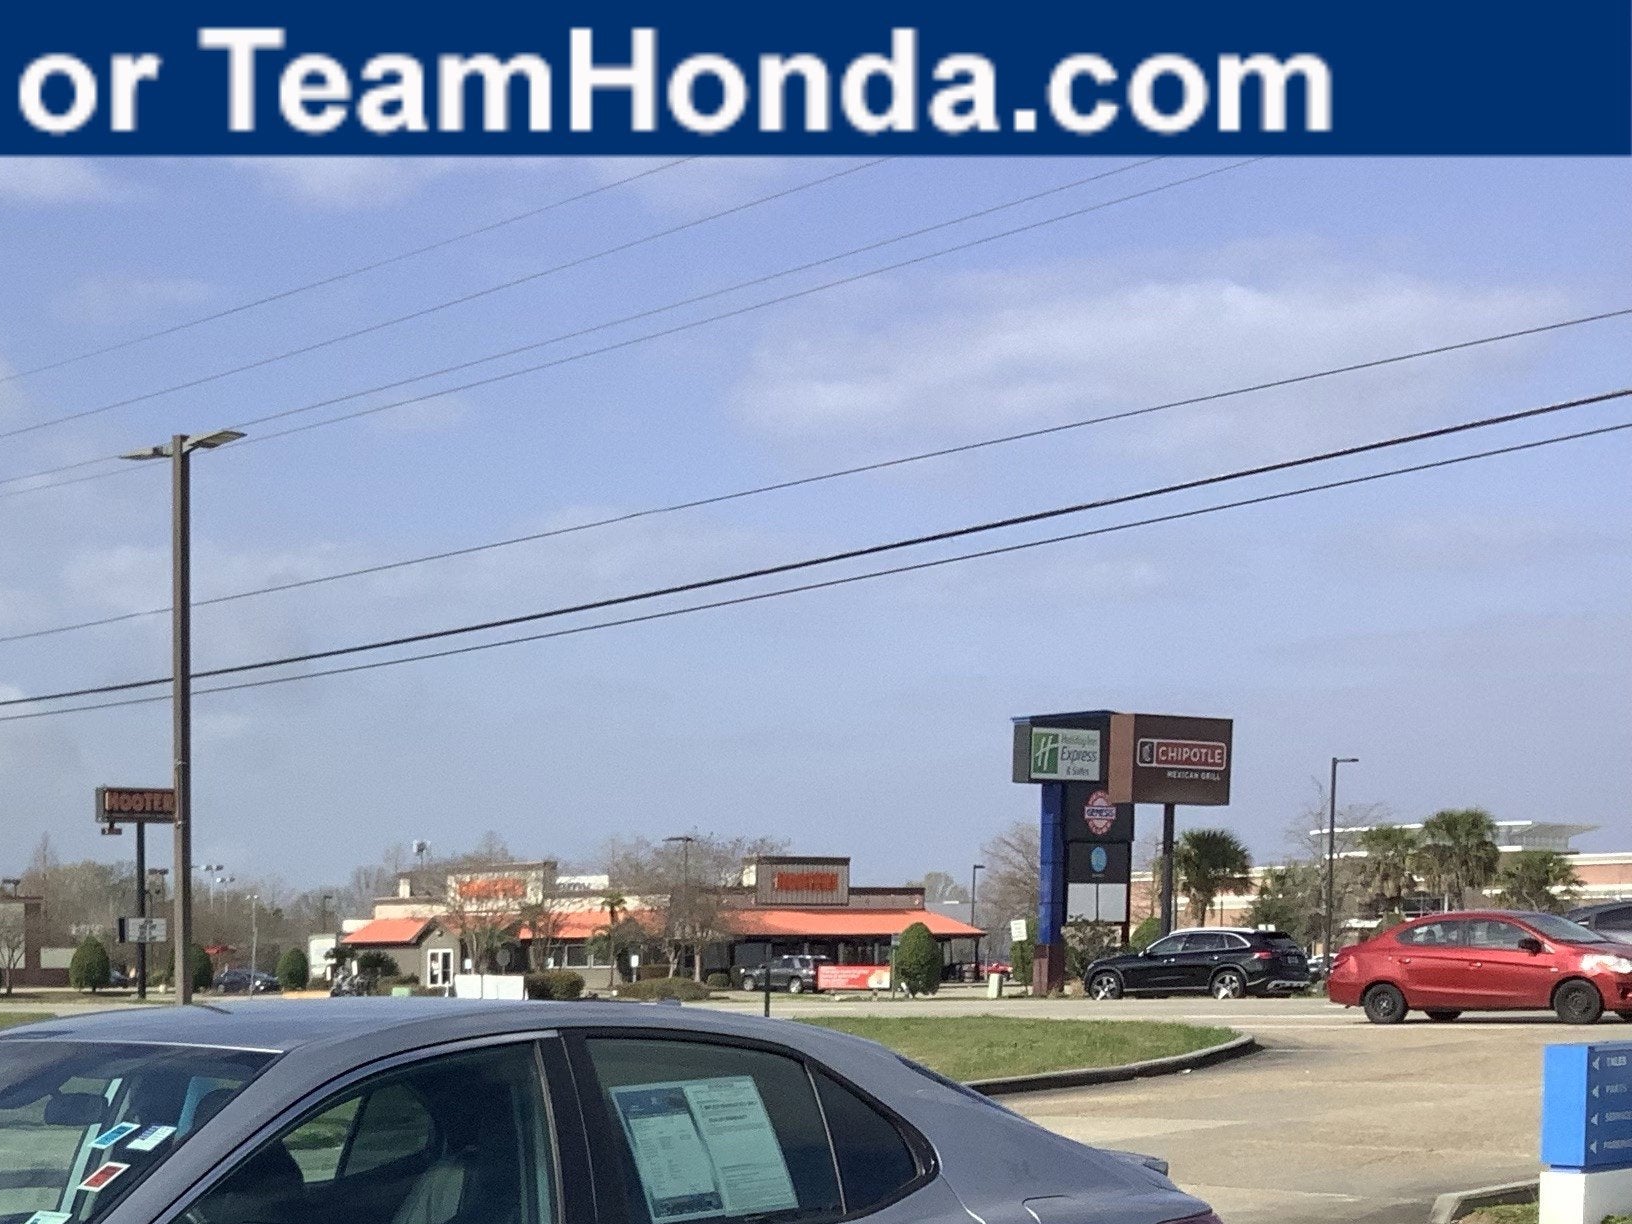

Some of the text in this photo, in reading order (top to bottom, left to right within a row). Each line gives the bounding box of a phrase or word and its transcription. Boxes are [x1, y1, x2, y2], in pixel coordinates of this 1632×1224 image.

[1061, 746, 1097, 764] Express
[1158, 746, 1223, 764] CHIPOTLE
[1167, 771, 1221, 780] MEXICAN GRILL
[105, 792, 176, 812] HOOTER
